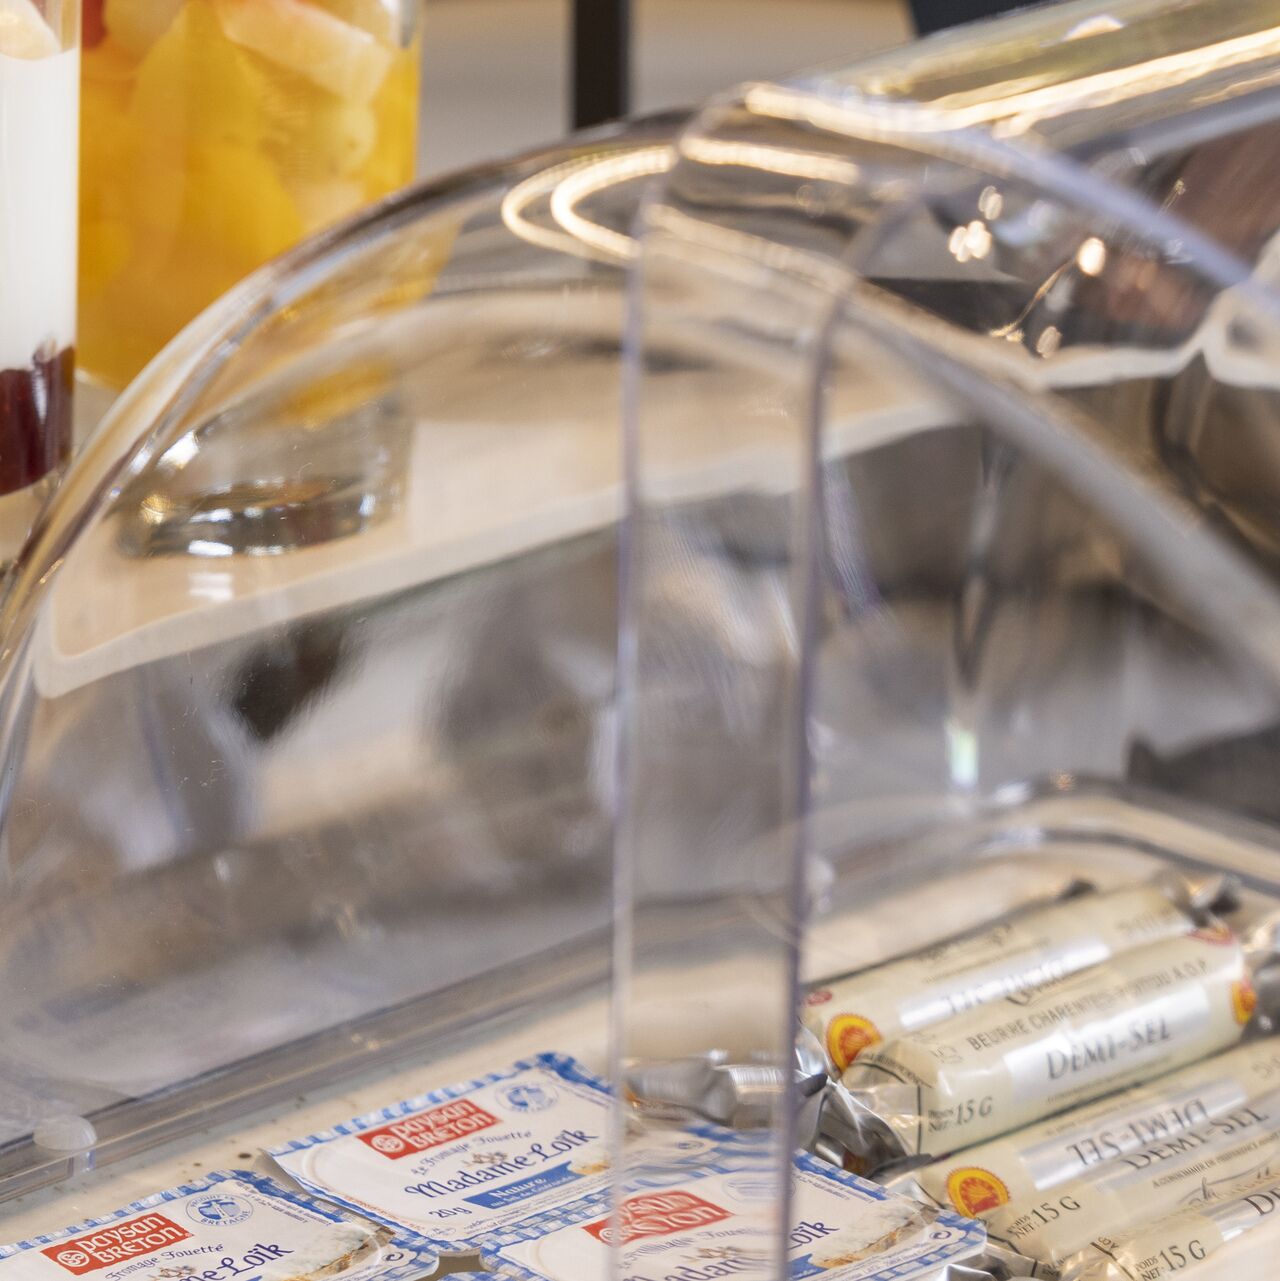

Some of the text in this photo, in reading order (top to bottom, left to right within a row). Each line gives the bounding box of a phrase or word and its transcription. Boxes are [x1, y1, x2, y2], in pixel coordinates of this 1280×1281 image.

[391, 1101, 476, 1137] paysan
[404, 1155, 536, 1199] Madame
[1031, 1202, 1060, 1224] 15
[1059, 1195, 1081, 1211] G
[76, 1215, 166, 1253] paysan
[92, 1226, 184, 1263] BRETON
[106, 1257, 159, 1281] Fromage
[161, 1243, 225, 1261] Fouetté
[217, 1243, 294, 1277] Loïk
[1159, 1244, 1187, 1273] 15
[1188, 1239, 1207, 1260] G
